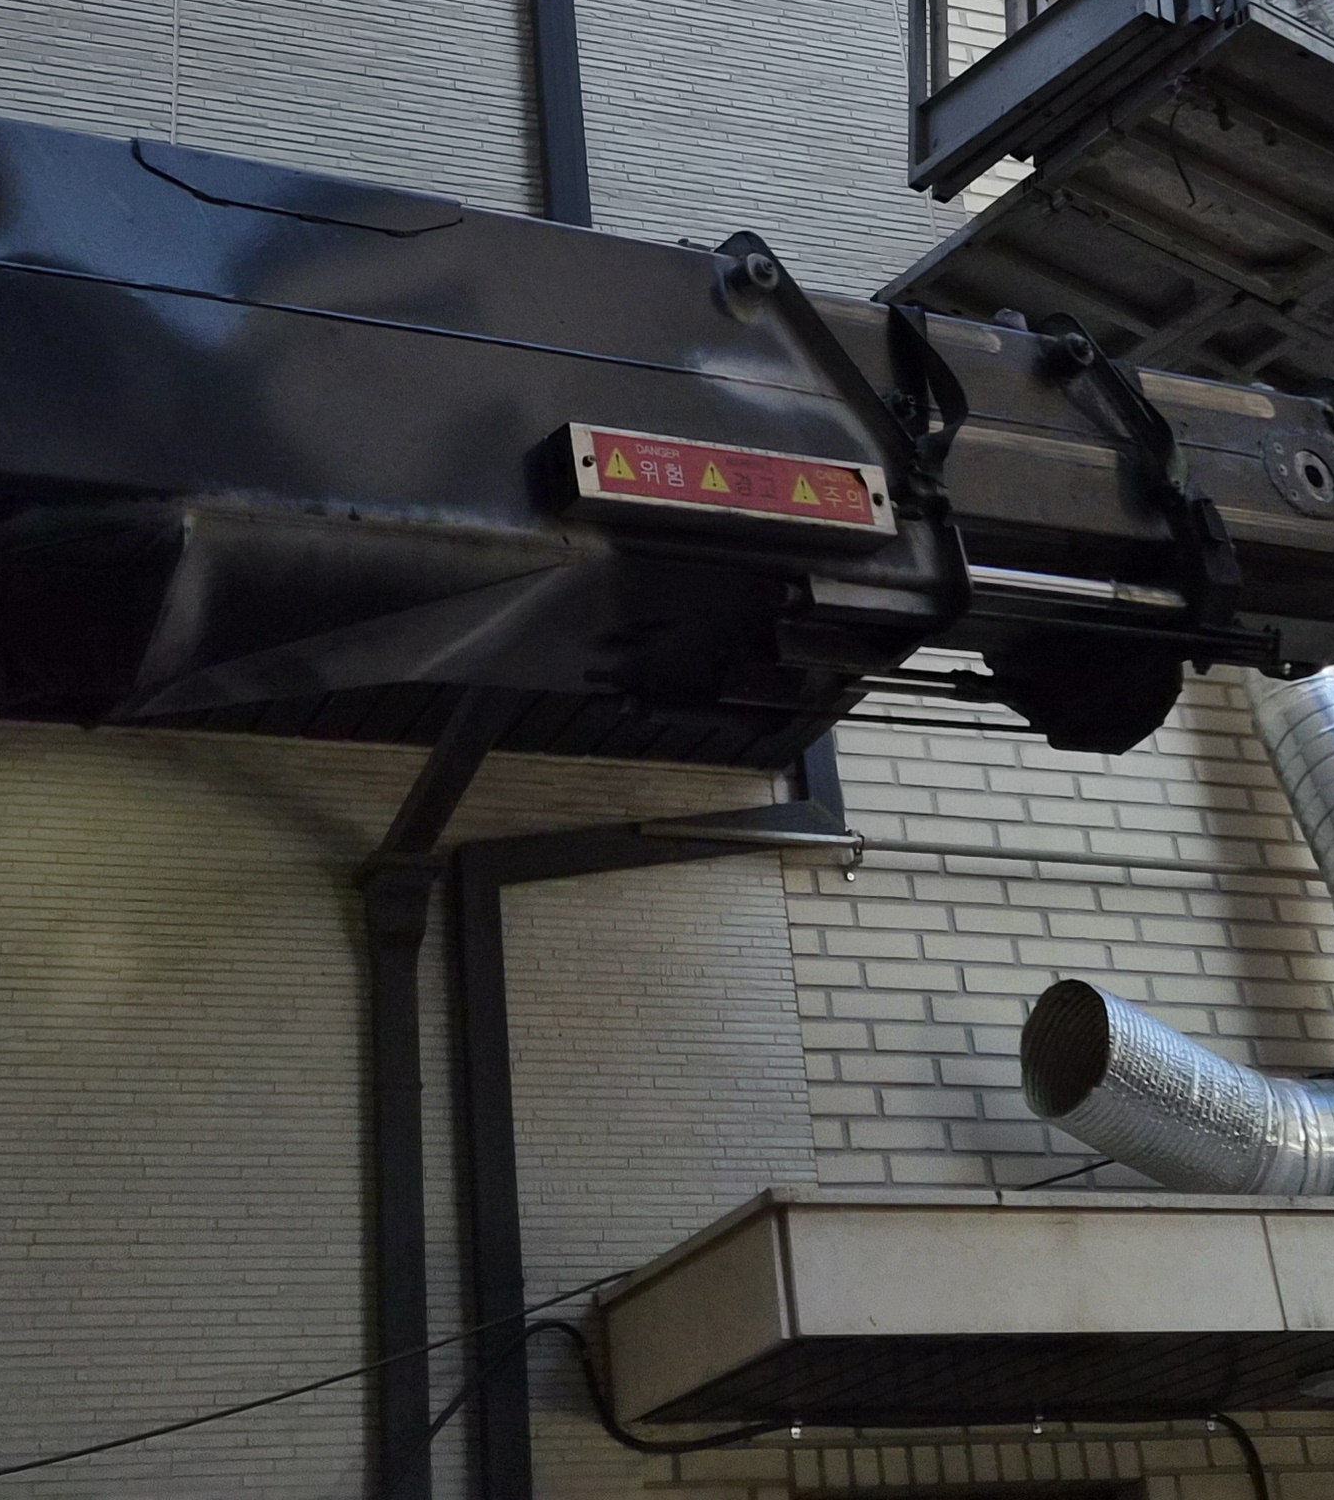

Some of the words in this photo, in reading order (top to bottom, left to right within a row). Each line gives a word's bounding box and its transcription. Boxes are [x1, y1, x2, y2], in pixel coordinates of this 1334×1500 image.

[635, 443, 680, 459] DANGER
[640, 460, 685, 488] 위험
[816, 470, 856, 485] CAUTIO
[823, 485, 865, 513] 주의
